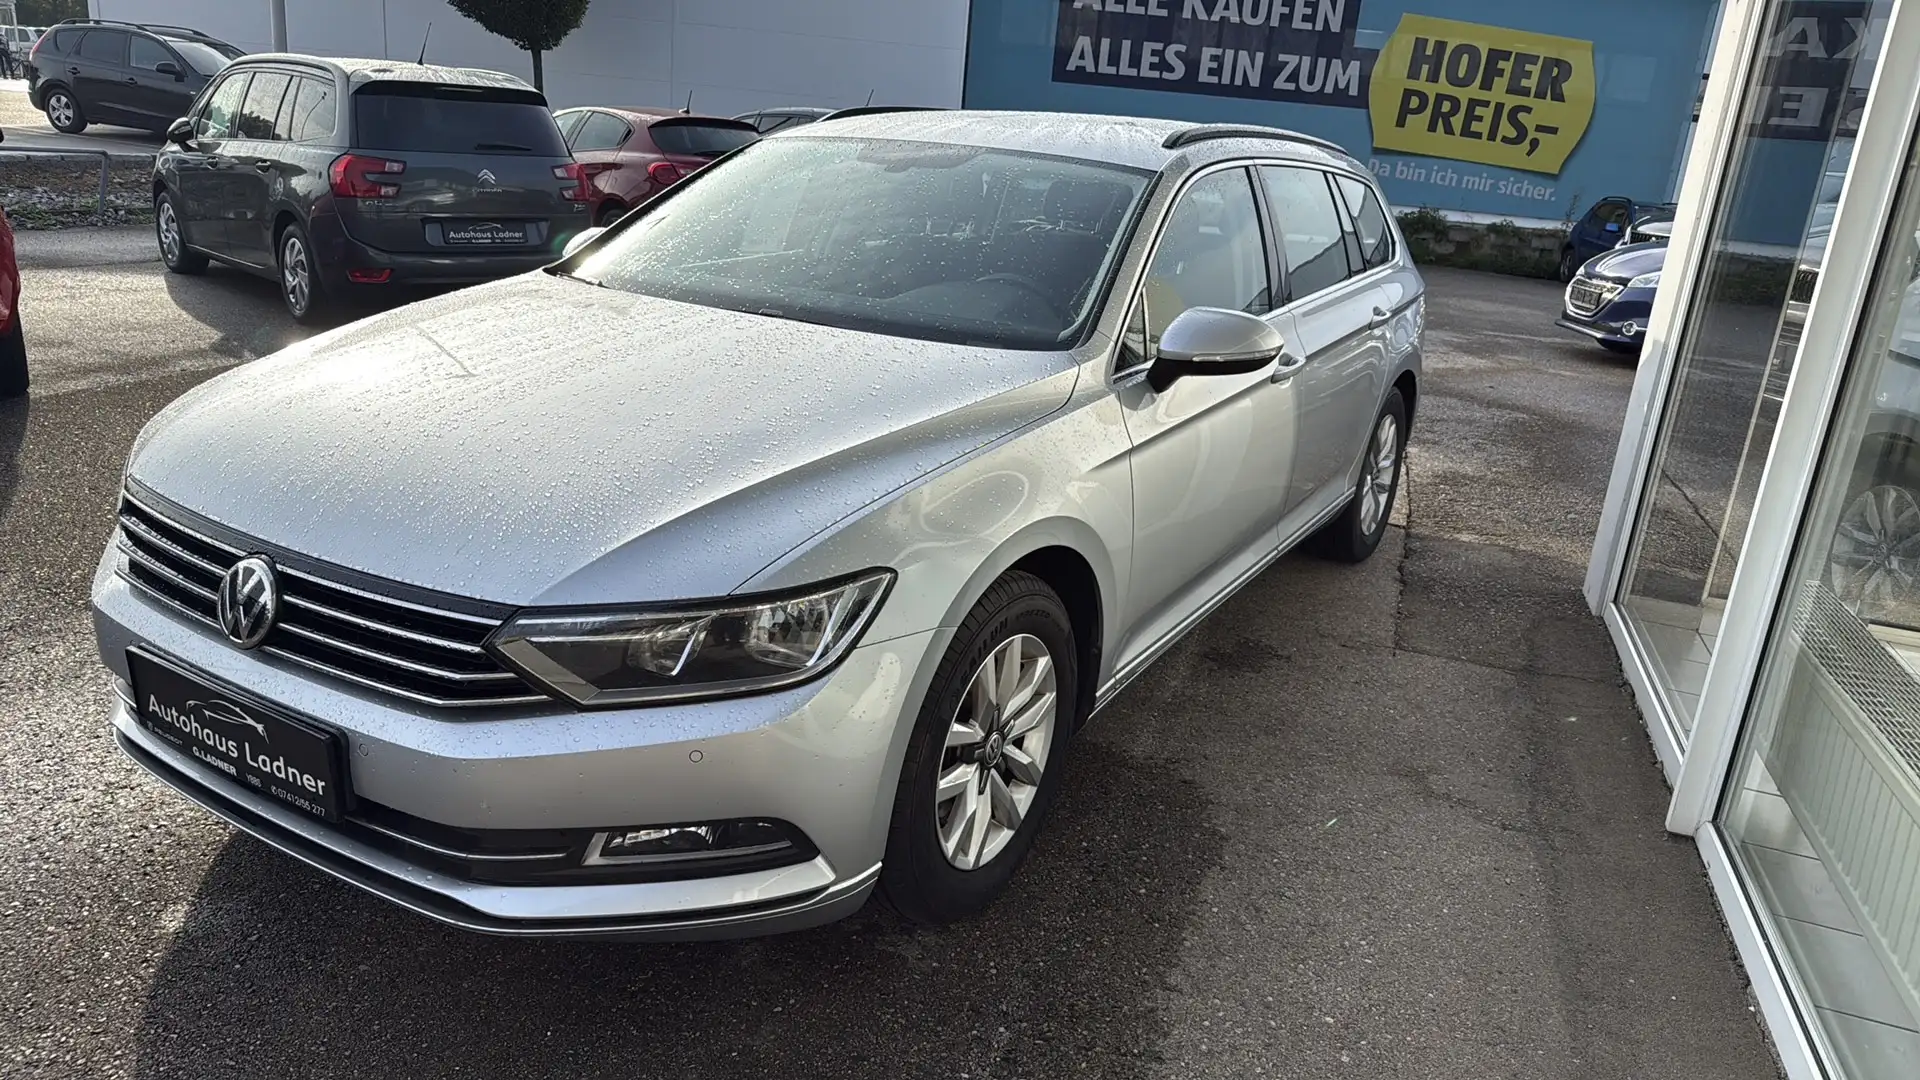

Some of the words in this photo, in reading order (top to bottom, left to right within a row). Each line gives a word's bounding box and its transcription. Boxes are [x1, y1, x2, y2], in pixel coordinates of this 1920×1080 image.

[1182, 0, 1344, 33] KAUFEN
[1066, 35, 1187, 81] ALLES
[1198, 47, 1264, 88] EIN
[1273, 54, 1360, 96] ZUM
[1406, 37, 1572, 103] HOFER
[1395, 88, 1559, 157] PREIS,-
[1367, 158, 1390, 177] Da
[1395, 160, 1424, 182] bin
[1430, 165, 1458, 187] ich
[1461, 173, 1494, 192] mir
[1497, 177, 1556, 200] sicher.
[149, 694, 239, 758] Autohaus
[245, 742, 325, 795] Ladner
